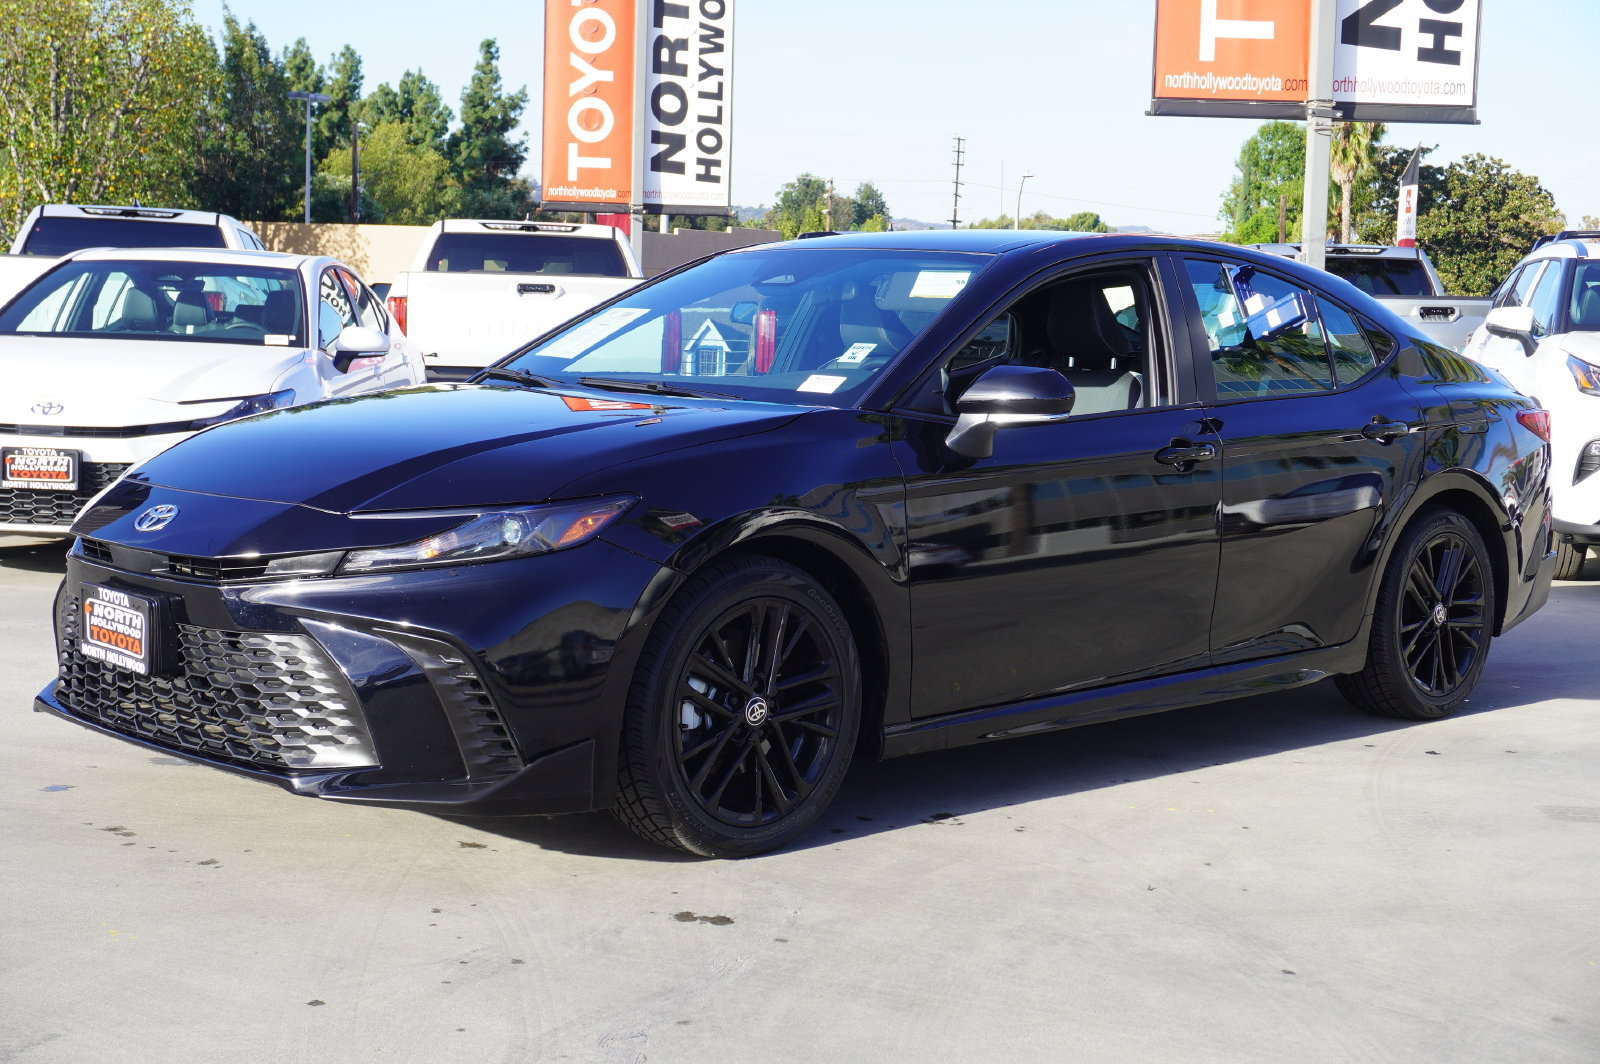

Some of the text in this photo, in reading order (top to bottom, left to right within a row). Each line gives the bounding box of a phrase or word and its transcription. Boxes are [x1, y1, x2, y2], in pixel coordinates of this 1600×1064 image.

[567, 0, 617, 182] TOYO
[1165, 72, 1308, 95] northhollywoodtoyota.com
[1332, 76, 1466, 98] orthhollywoodtoyota.com
[548, 185, 631, 201] northhollywoodtoyota.com
[14, 457, 69, 466] NORTH
[22, 448, 57, 456] TOYOTA
[10, 470, 69, 480] TOYOTA
[11, 464, 67, 472] HOLLYWOOD
[2, 480, 76, 490] NORTH HOLLYWOOD
[97, 587, 130, 608] TOYOTA
[93, 603, 142, 629] NORTH
[90, 615, 142, 639] HOLLYWOOD
[90, 626, 142, 655] TOYOTA
[81, 643, 145, 674] NORTH HOLLYWOOD
